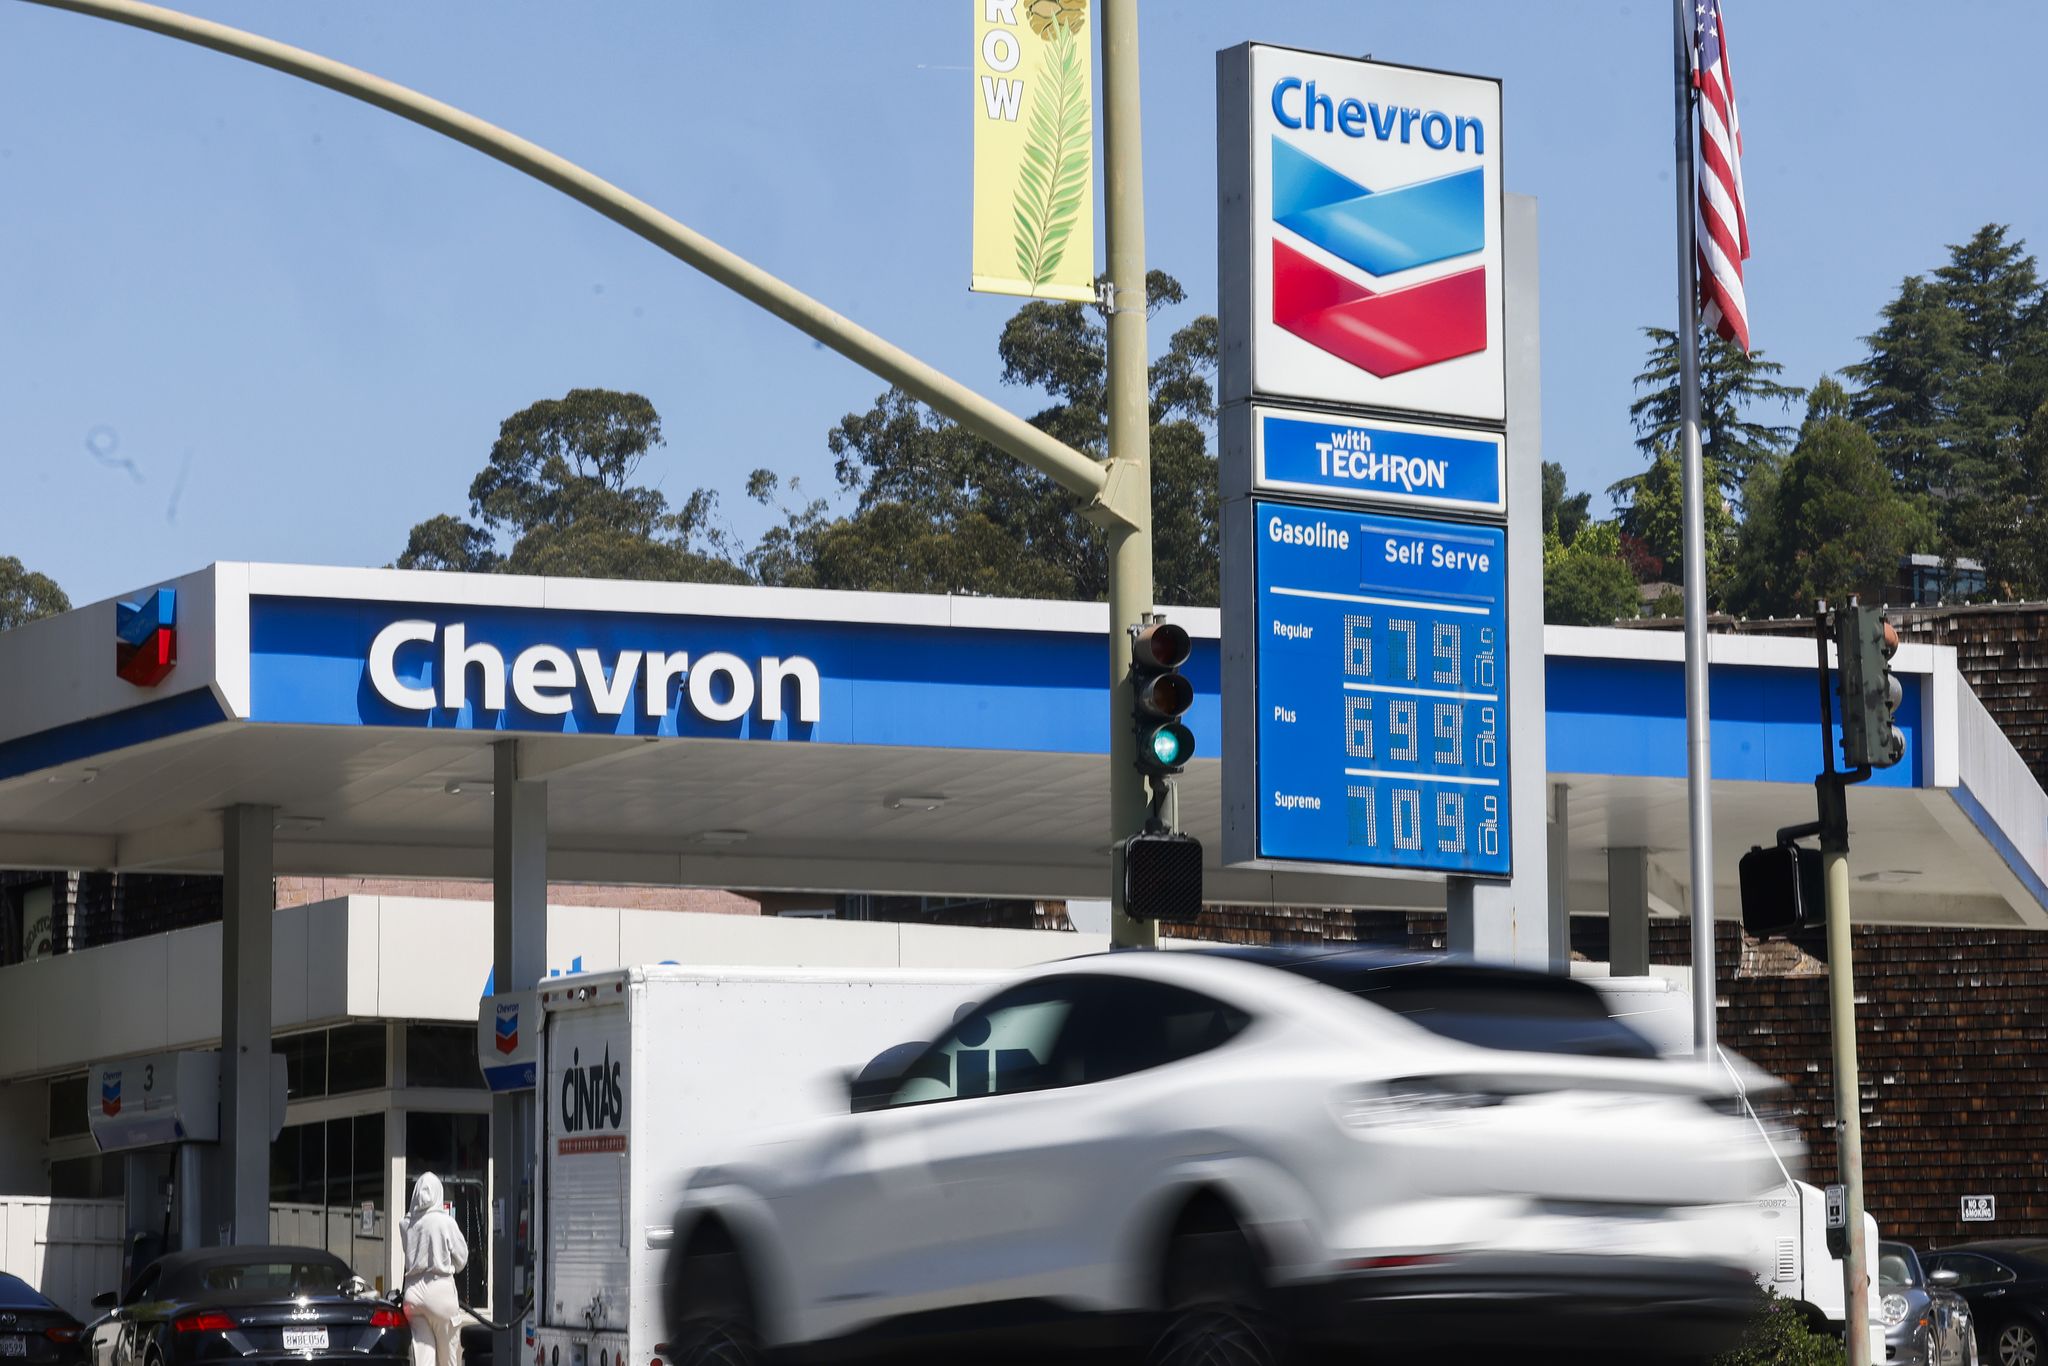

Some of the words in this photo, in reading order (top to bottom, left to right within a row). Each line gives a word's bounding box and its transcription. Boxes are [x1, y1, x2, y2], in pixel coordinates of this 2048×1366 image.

[1271, 76, 1484, 155] Chevron
[1331, 429, 1371, 451] with
[1316, 442, 1446, 492] TECHRON
[1269, 516, 1349, 550] Gasoline
[1385, 538, 1424, 565] Self
[1431, 543, 1490, 573] Serve
[1273, 620, 1313, 640] Regular
[1344, 614, 1461, 684] 679
[369, 619, 820, 722] Chevron
[1274, 706, 1297, 723] Plus
[1345, 696, 1463, 765] 699
[1275, 791, 1321, 810] Supreme
[1347, 785, 1466, 853] 709
[496, 1003, 520, 1014] Chevron
[144, 1064, 154, 1092] 3
[1758, 1199, 1787, 1208] 200872
[1965, 1208, 1992, 1218] SMOKING
[1968, 1199, 1977, 1209] NO
